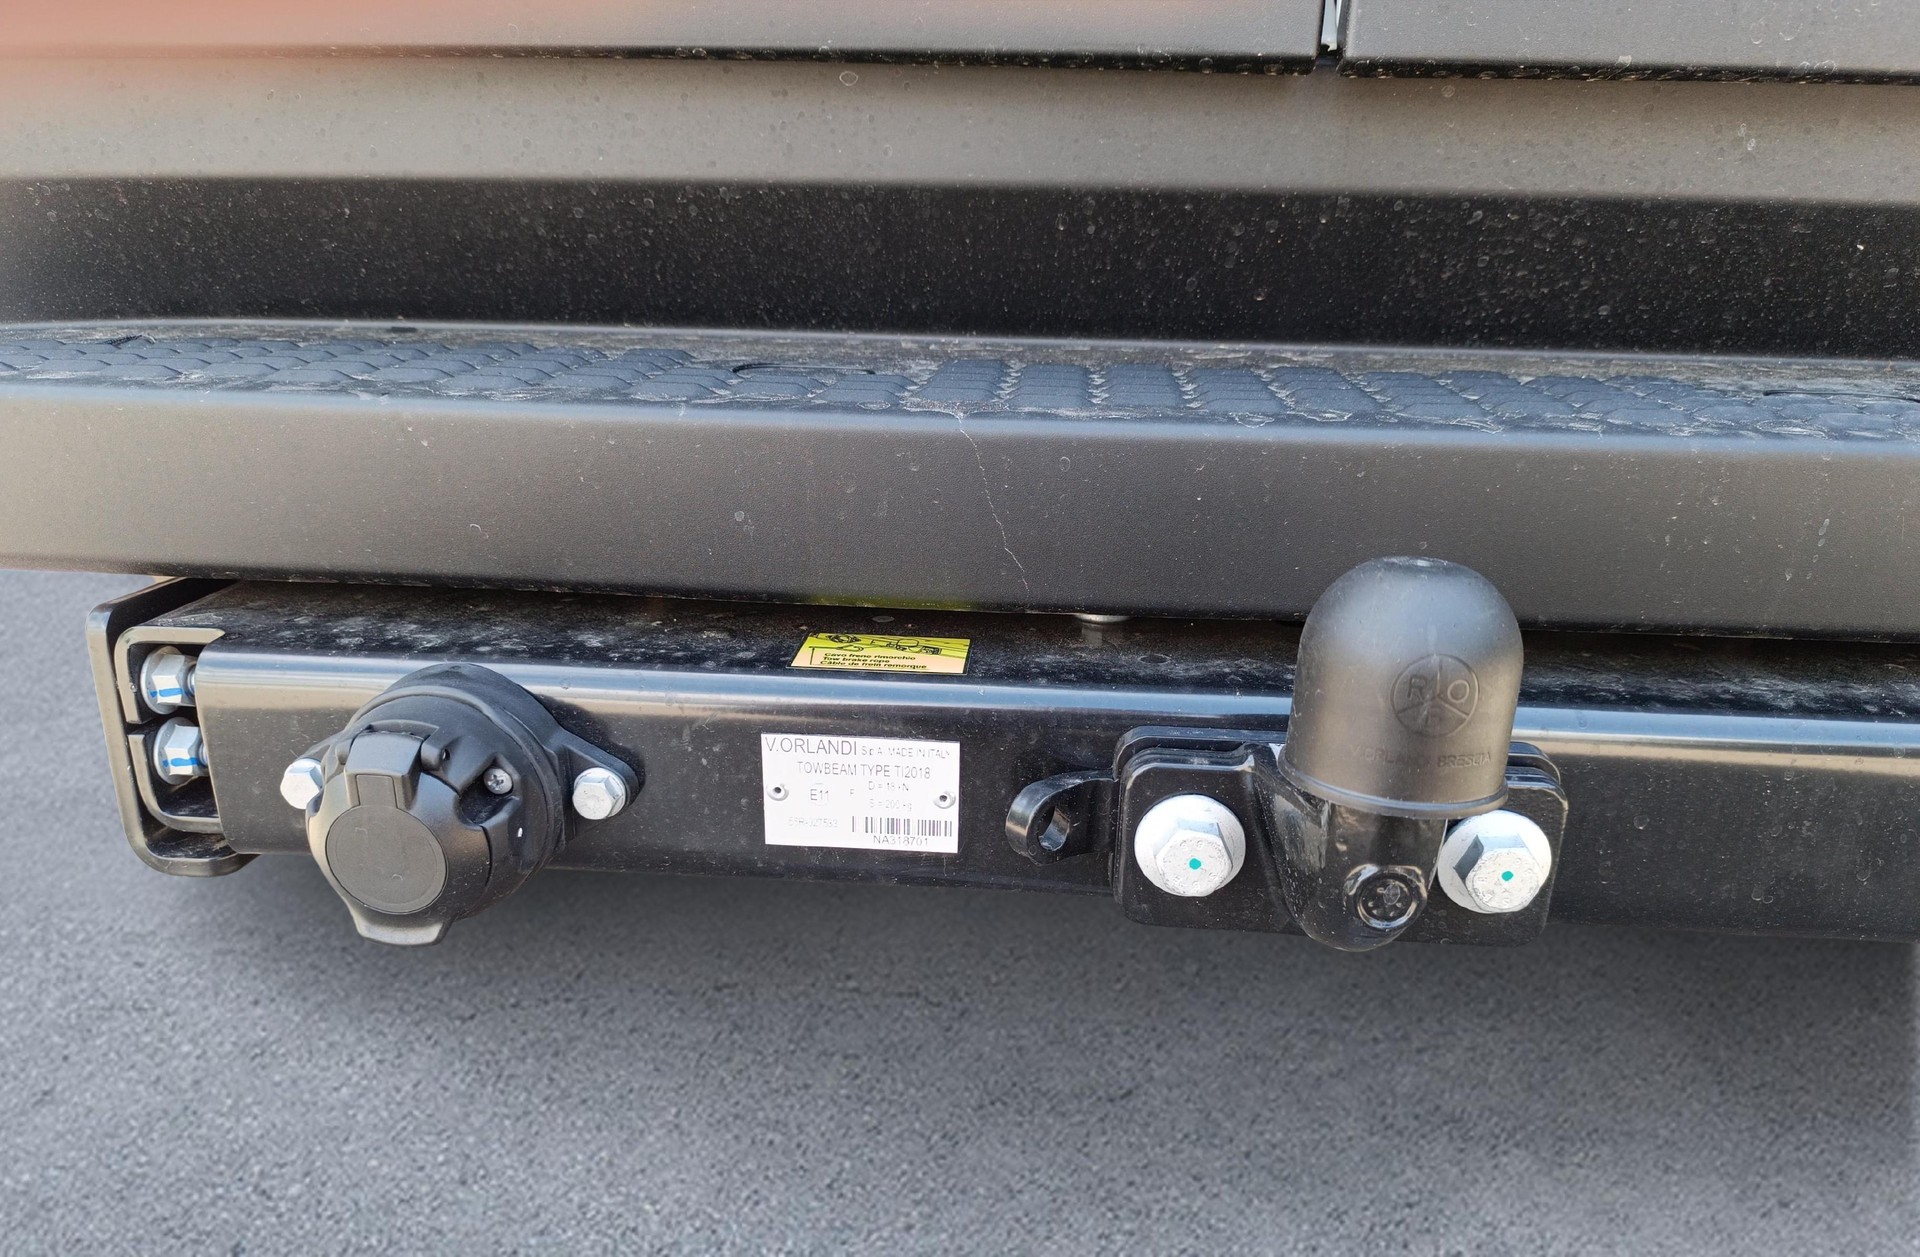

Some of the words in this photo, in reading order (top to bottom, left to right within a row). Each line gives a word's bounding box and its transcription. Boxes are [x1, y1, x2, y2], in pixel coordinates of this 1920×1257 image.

[765, 737, 857, 756] V.ORLANDI
[888, 747, 913, 758] MADE
[797, 761, 857, 776] TOWBEAM
[860, 764, 891, 778] TYPE
[868, 780, 876, 791] D
[810, 788, 829, 801] E11
